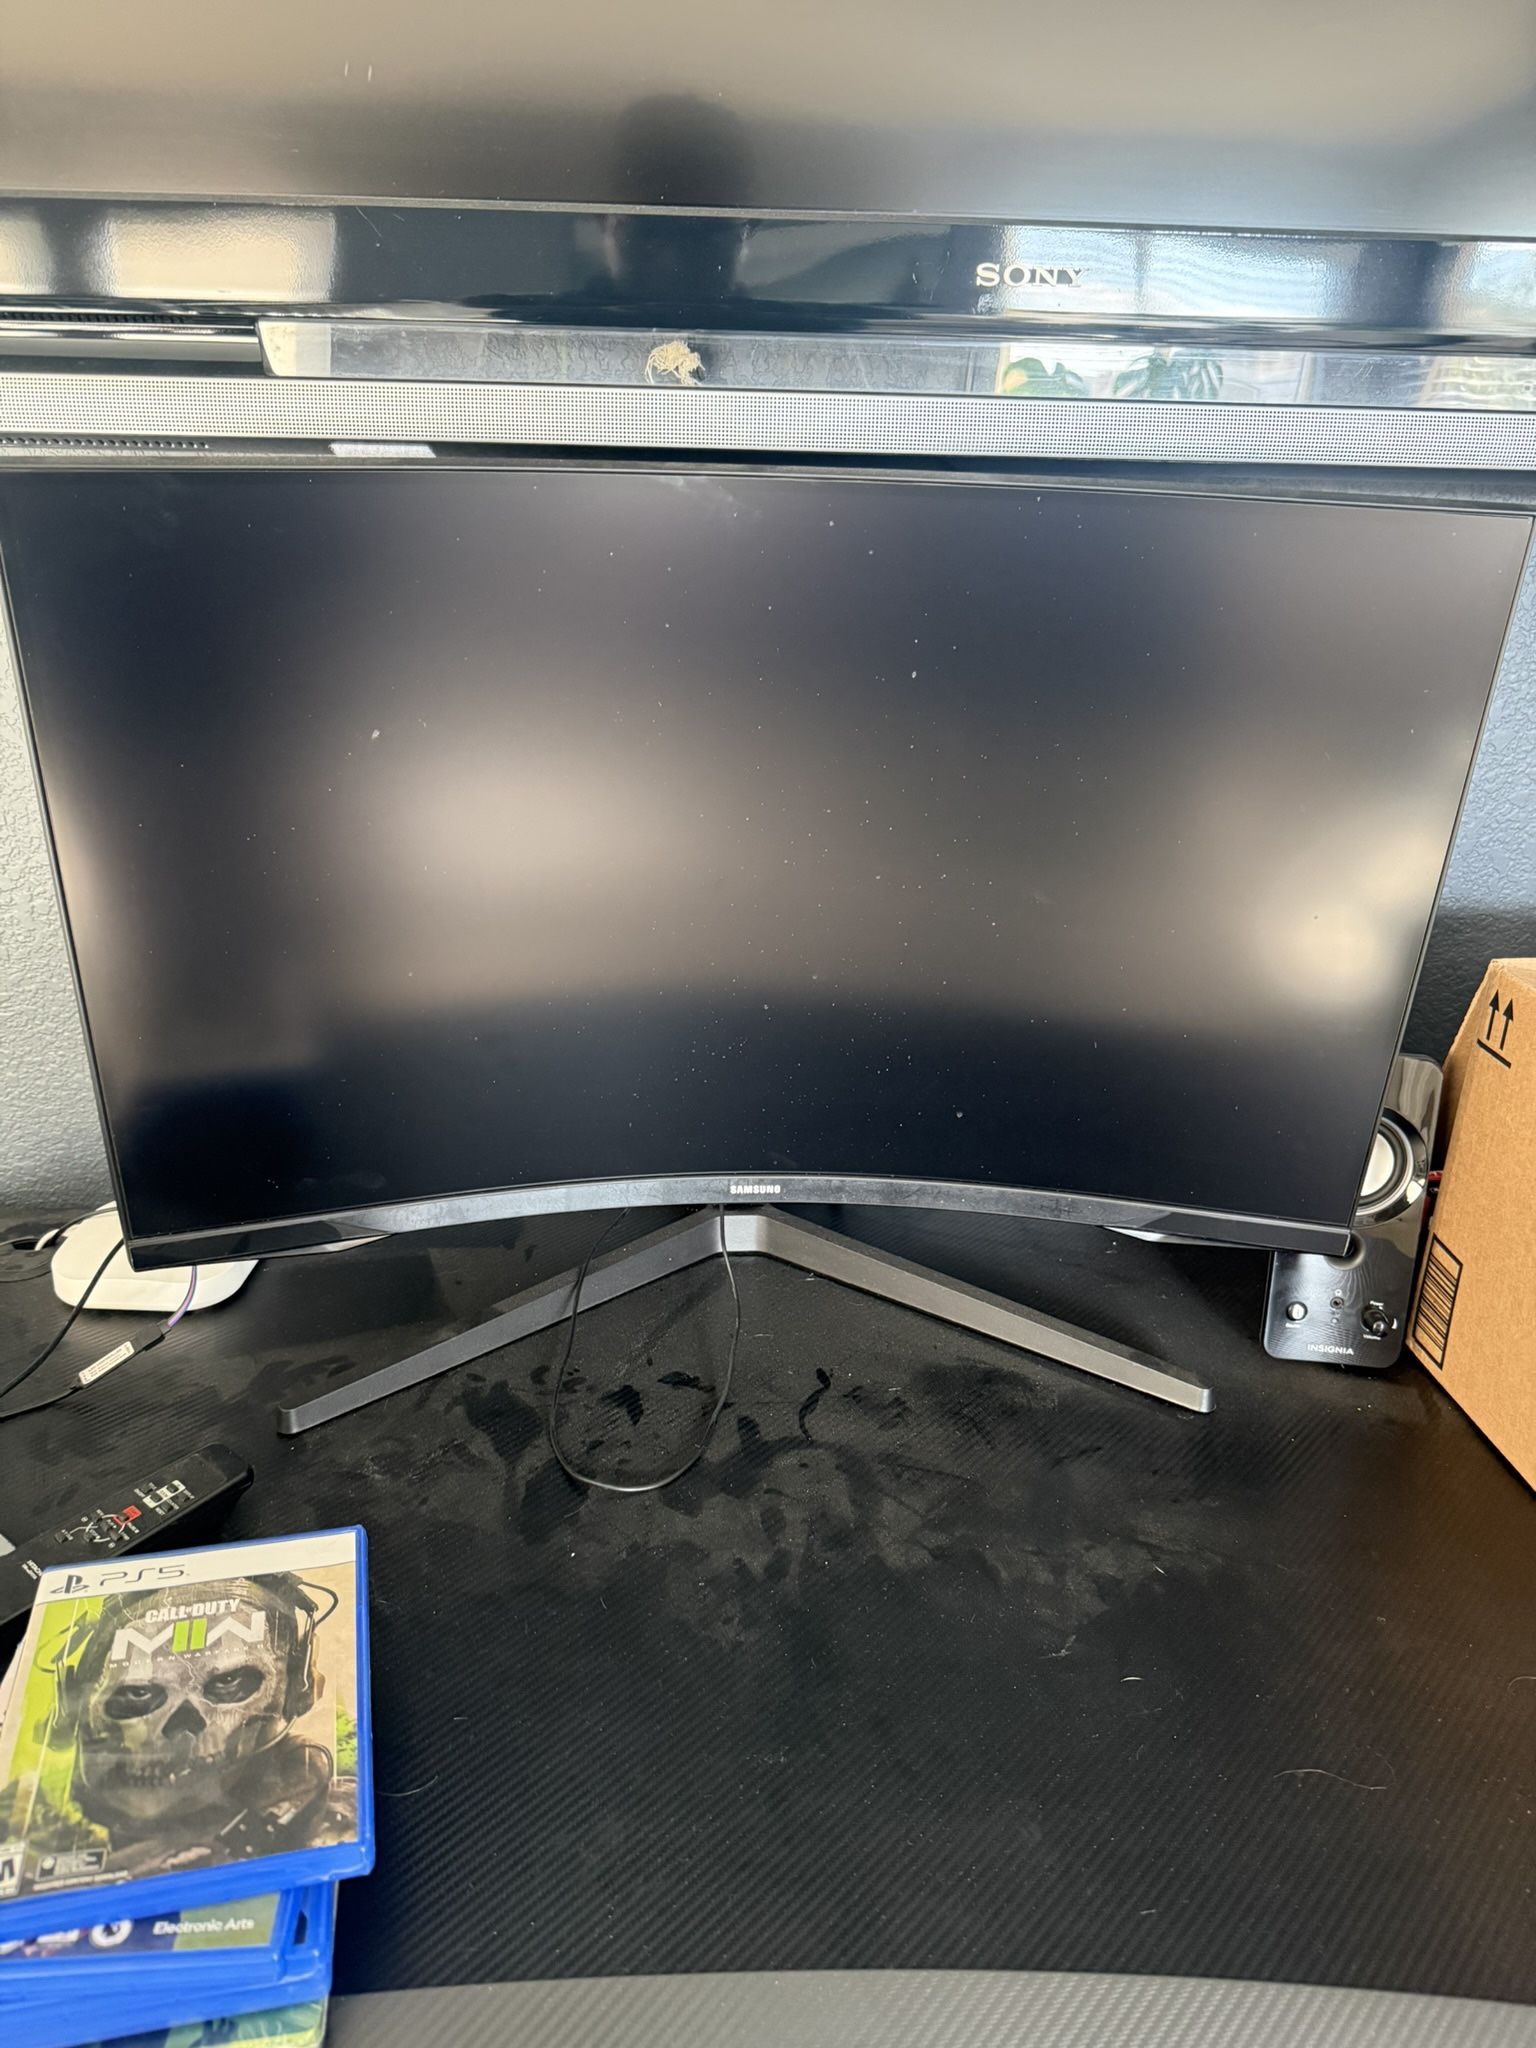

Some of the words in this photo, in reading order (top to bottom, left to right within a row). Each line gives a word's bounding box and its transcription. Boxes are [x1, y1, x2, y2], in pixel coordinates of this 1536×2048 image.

[976, 262, 1089, 287] SONY
[730, 1185, 781, 1194] SAMSUNG
[1307, 1343, 1354, 1355] INSIGNIA
[100, 1564, 185, 1586] PS5
[145, 1605, 187, 1623] CALL
[192, 1599, 240, 1616] DUTY
[152, 1919, 223, 1935] Electronic
[224, 1917, 254, 1931] Arts
